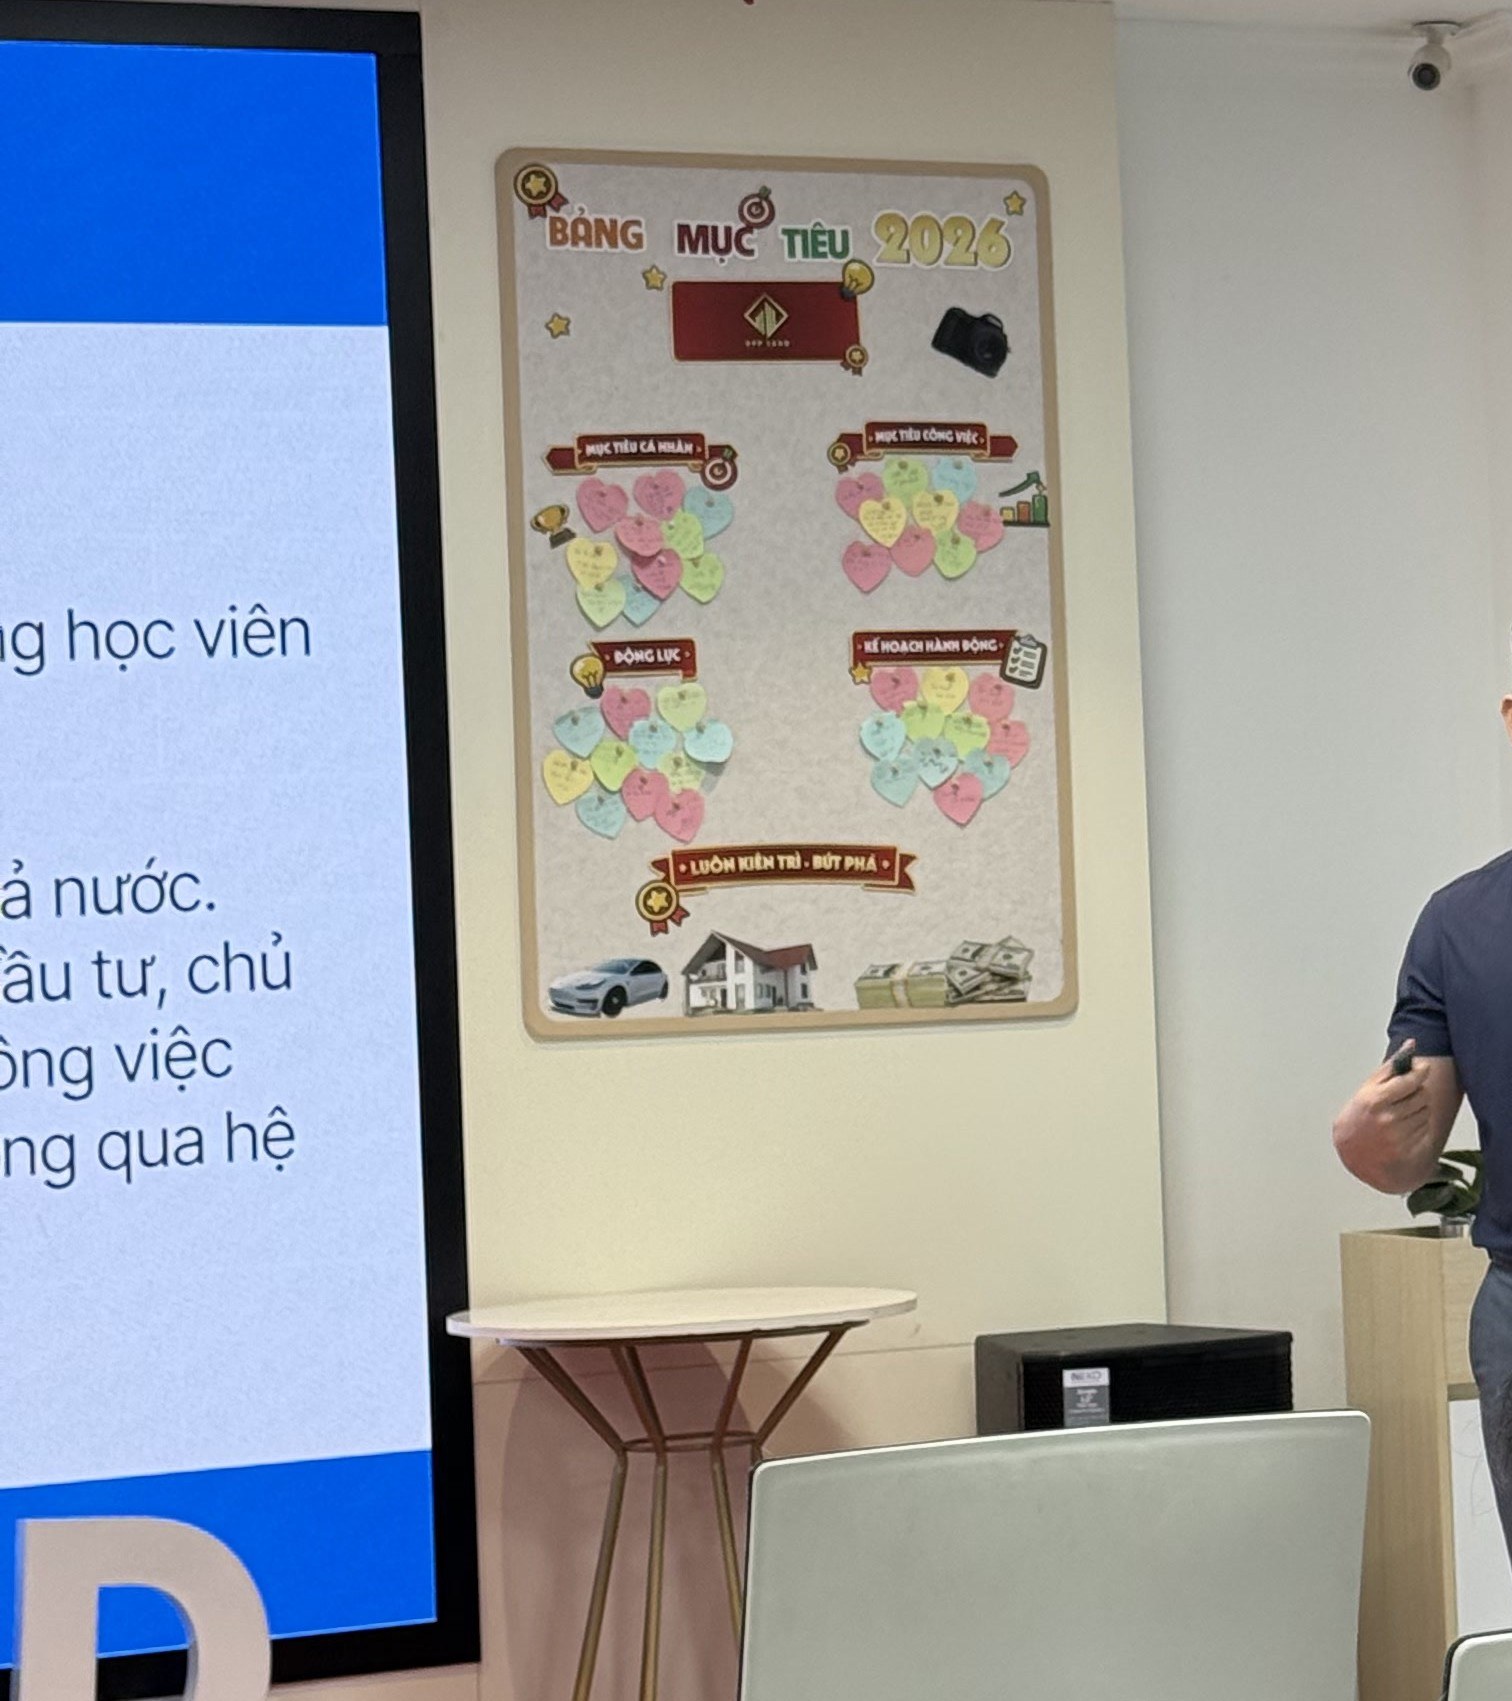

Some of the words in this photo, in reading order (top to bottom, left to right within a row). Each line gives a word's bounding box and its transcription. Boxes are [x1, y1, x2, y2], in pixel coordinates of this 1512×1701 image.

[549, 206, 644, 250] BẢNG
[677, 222, 755, 264] MỤC
[781, 221, 850, 260] TIÊU
[874, 212, 1012, 268] 2026
[640, 438, 656, 454] CÁ
[922, 426, 954, 443] CÔNG
[67, 608, 176, 672] học
[194, 603, 311, 658] viên
[614, 646, 656, 666] ĐỘNG
[863, 636, 881, 654] KẾ
[881, 639, 924, 656] HOẠCH
[925, 636, 960, 653] HÀNH
[962, 635, 998, 655] ĐỘNG
[54, 856, 215, 918] nước.
[690, 854, 736, 876] LUÔN
[737, 852, 775, 873] KIÊN
[776, 850, 801, 871] TRÌ
[844, 853, 878, 873] PHÁ
[91, 950, 167, 1010] tư,
[187, 931, 292, 995] chủ
[114, 1024, 233, 1092] việc
[3, 1133, 76, 1190] ng
[97, 1126, 204, 1185] qua
[225, 1105, 295, 1172] hệ
